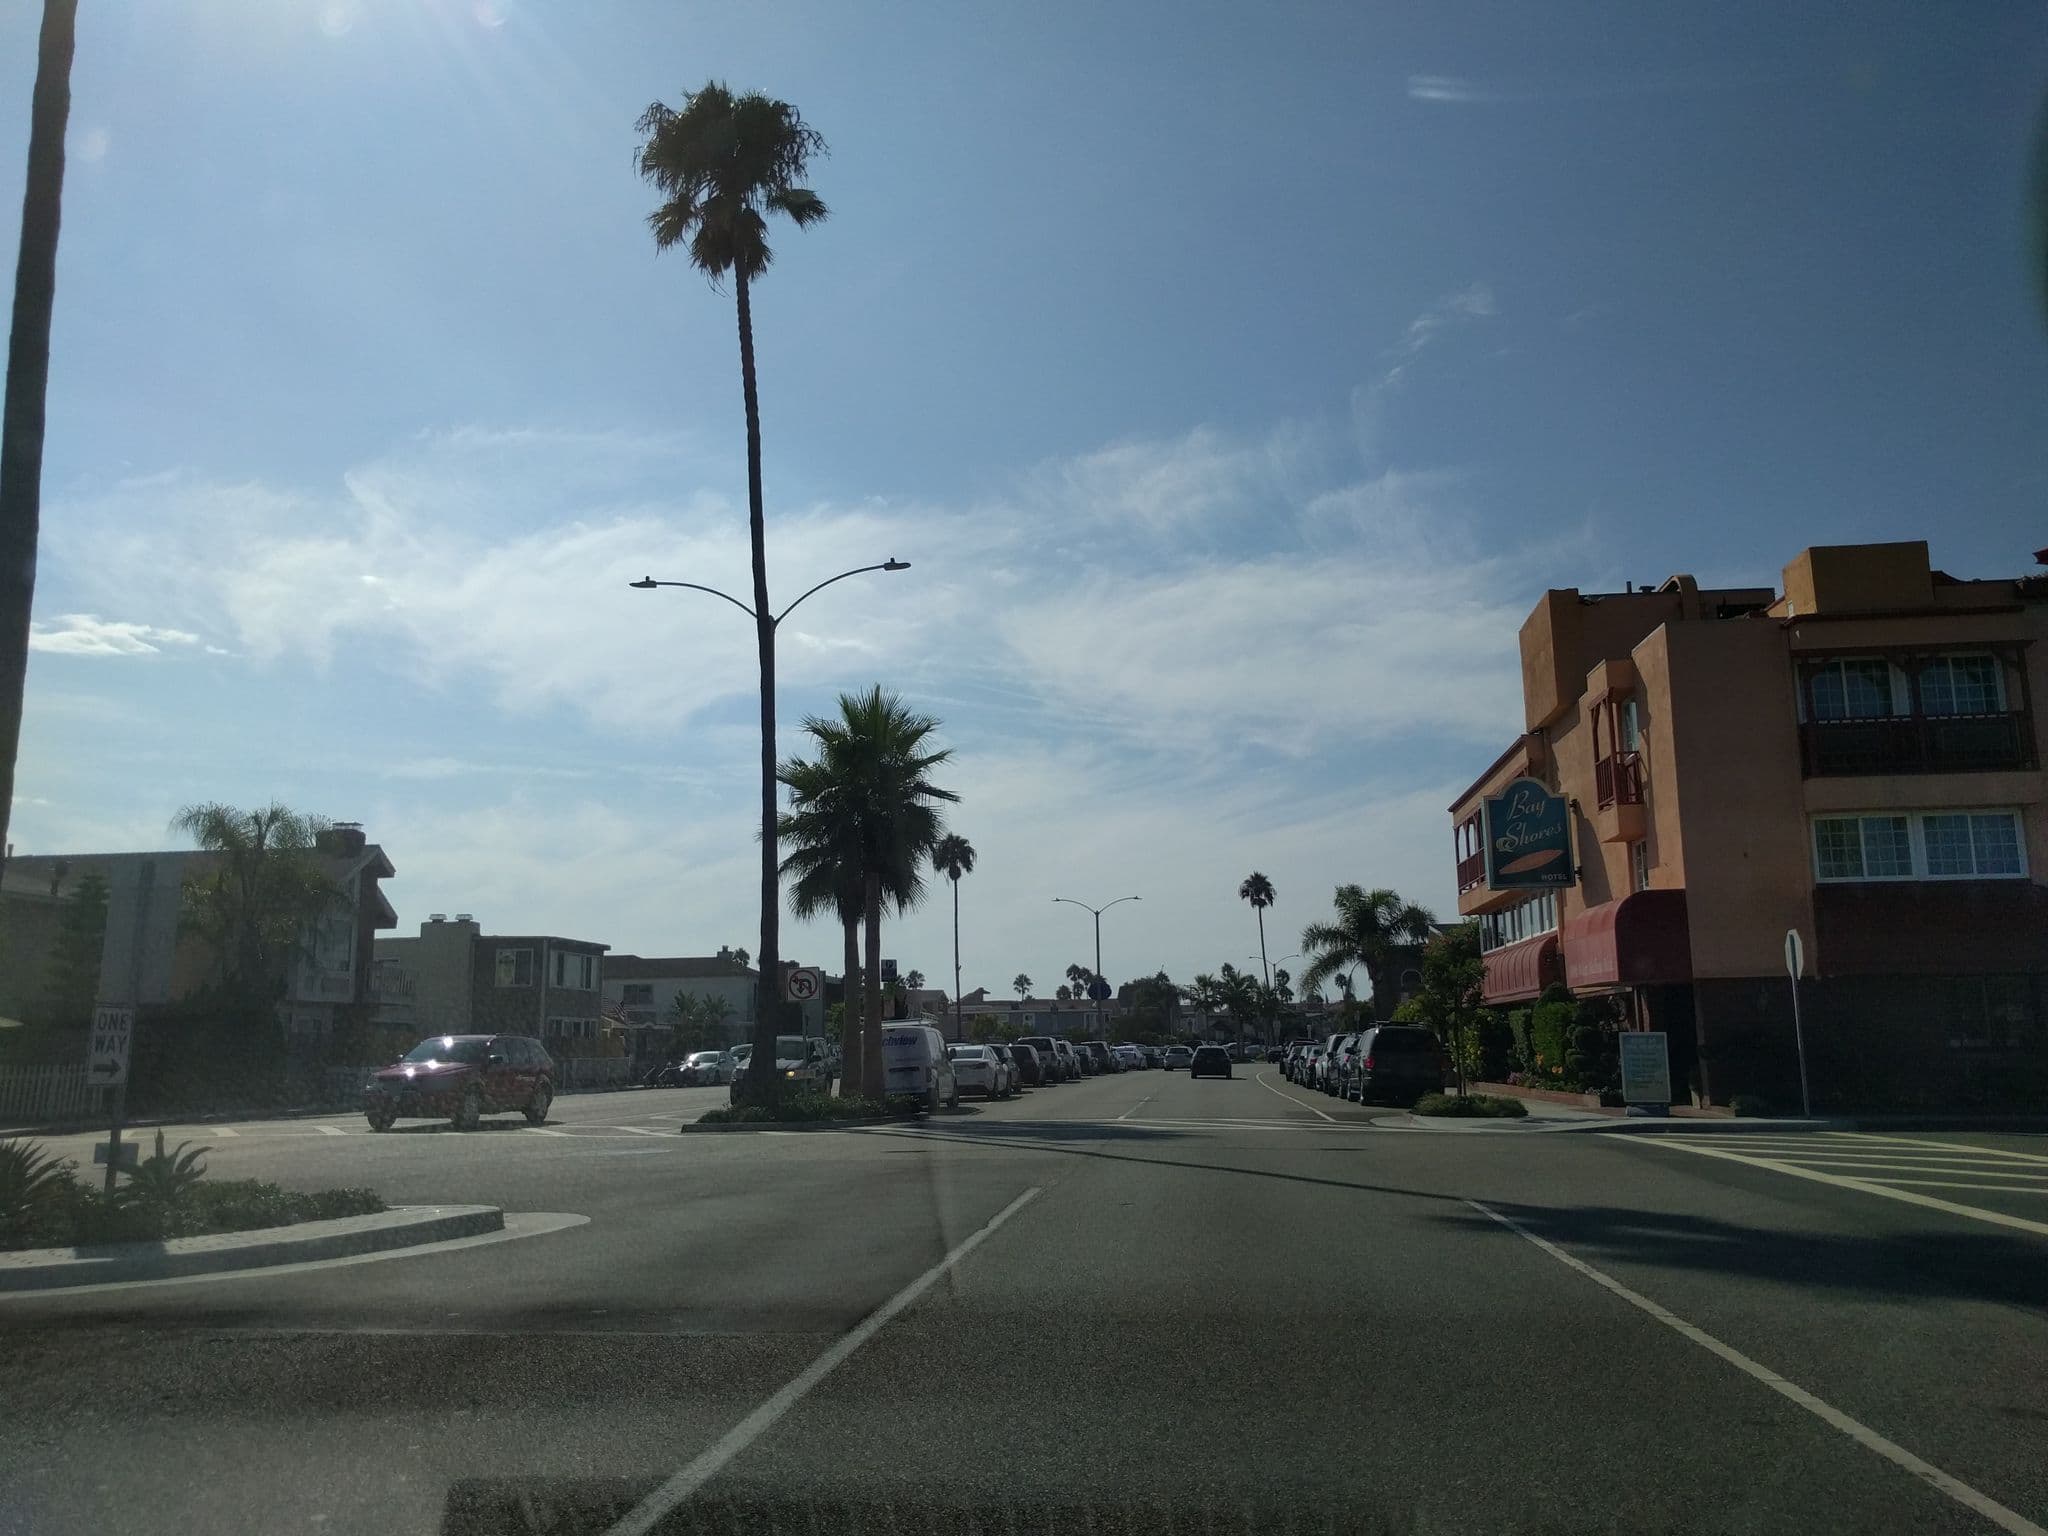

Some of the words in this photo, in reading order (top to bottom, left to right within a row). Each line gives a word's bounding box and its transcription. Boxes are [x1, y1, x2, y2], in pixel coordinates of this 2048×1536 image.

[1507, 790, 1545, 821] Bay
[1496, 821, 1562, 852] Shores
[1541, 873, 1569, 881] HOTEL
[98, 1013, 127, 1030] ONE
[95, 1034, 127, 1054] WAY
